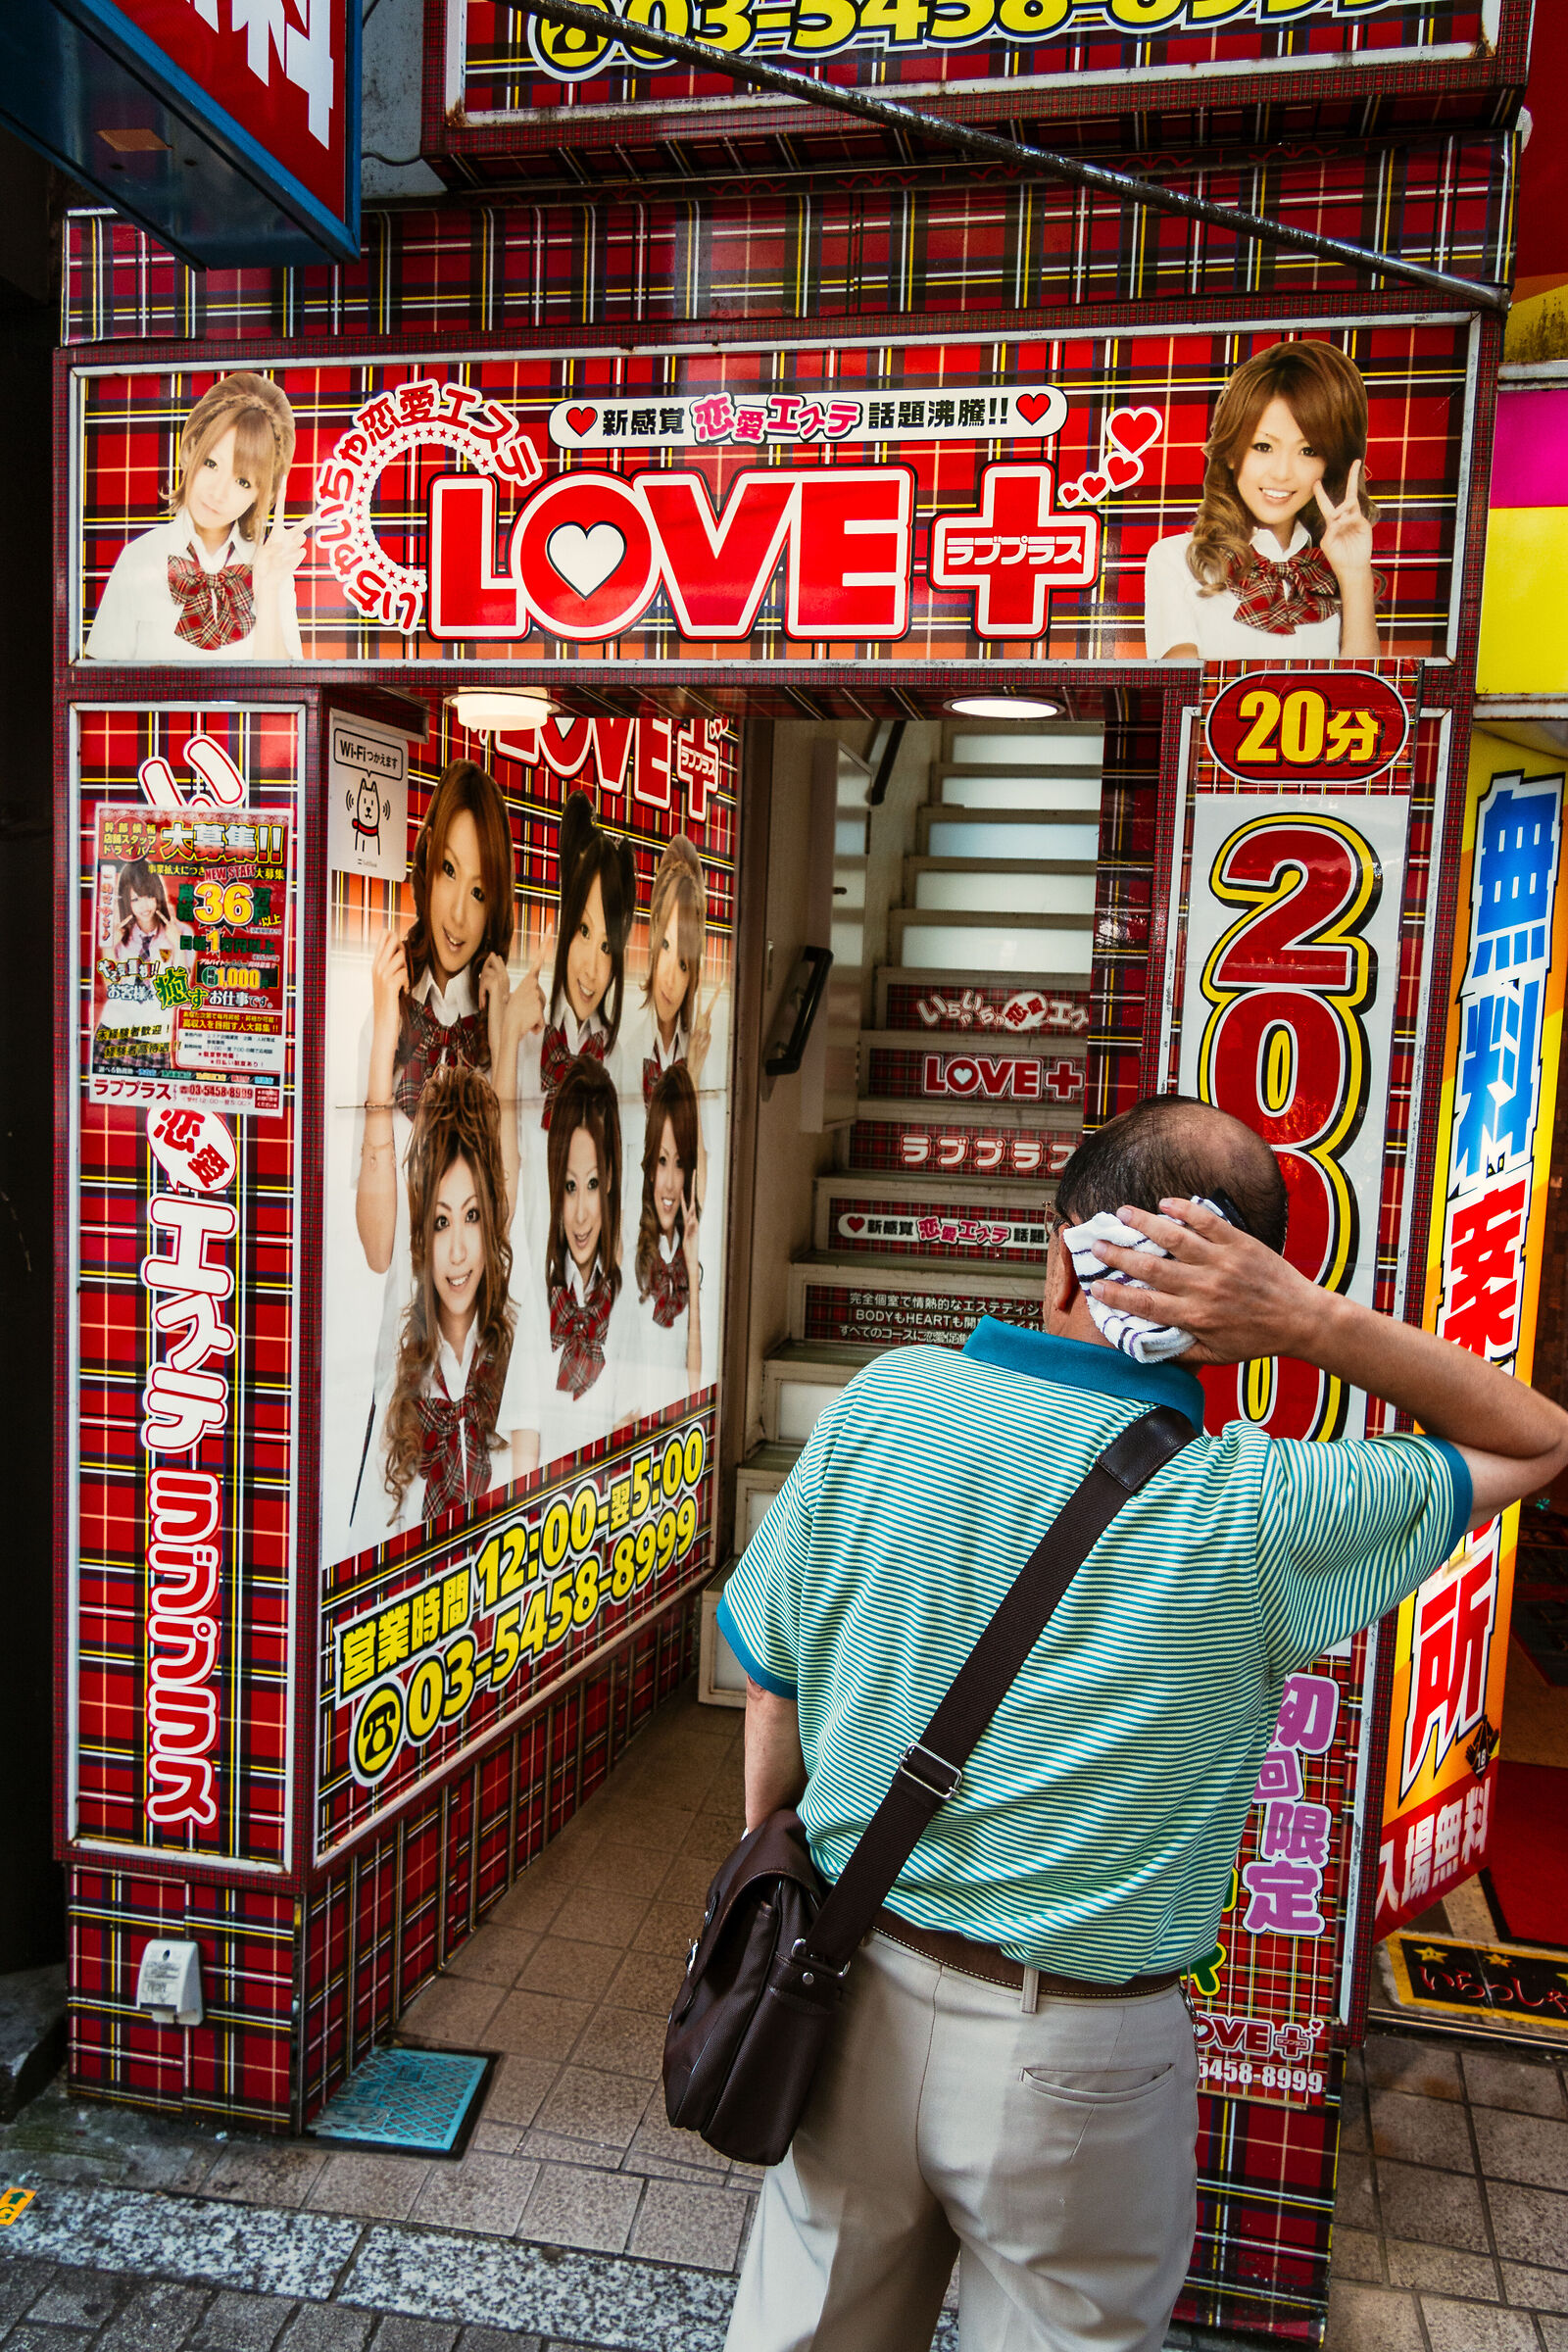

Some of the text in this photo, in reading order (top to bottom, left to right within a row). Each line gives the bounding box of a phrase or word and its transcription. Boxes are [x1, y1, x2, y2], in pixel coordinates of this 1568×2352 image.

[946, 536, 1083, 566] ラブプラス
[1237, 689, 1380, 764] 20分
[103, 845, 157, 857] ドライバー
[161, 821, 285, 864] 大募集!!
[204, 866, 227, 881] NEW
[227, 864, 256, 879] STAFF
[255, 867, 285, 881] 大募集
[93, 1078, 172, 1101] ラブプラス
[866, 1215, 1049, 1247] 新感覚恋愛エステ話題
[850, 1292, 1044, 1316] 完全個室で情熱的なエステティシ
[405, 1493, 698, 1745] 03-5458-8999
[144, 1468, 222, 1829] ラブプラス
[1374, 1776, 1492, 1922] 入場無料
